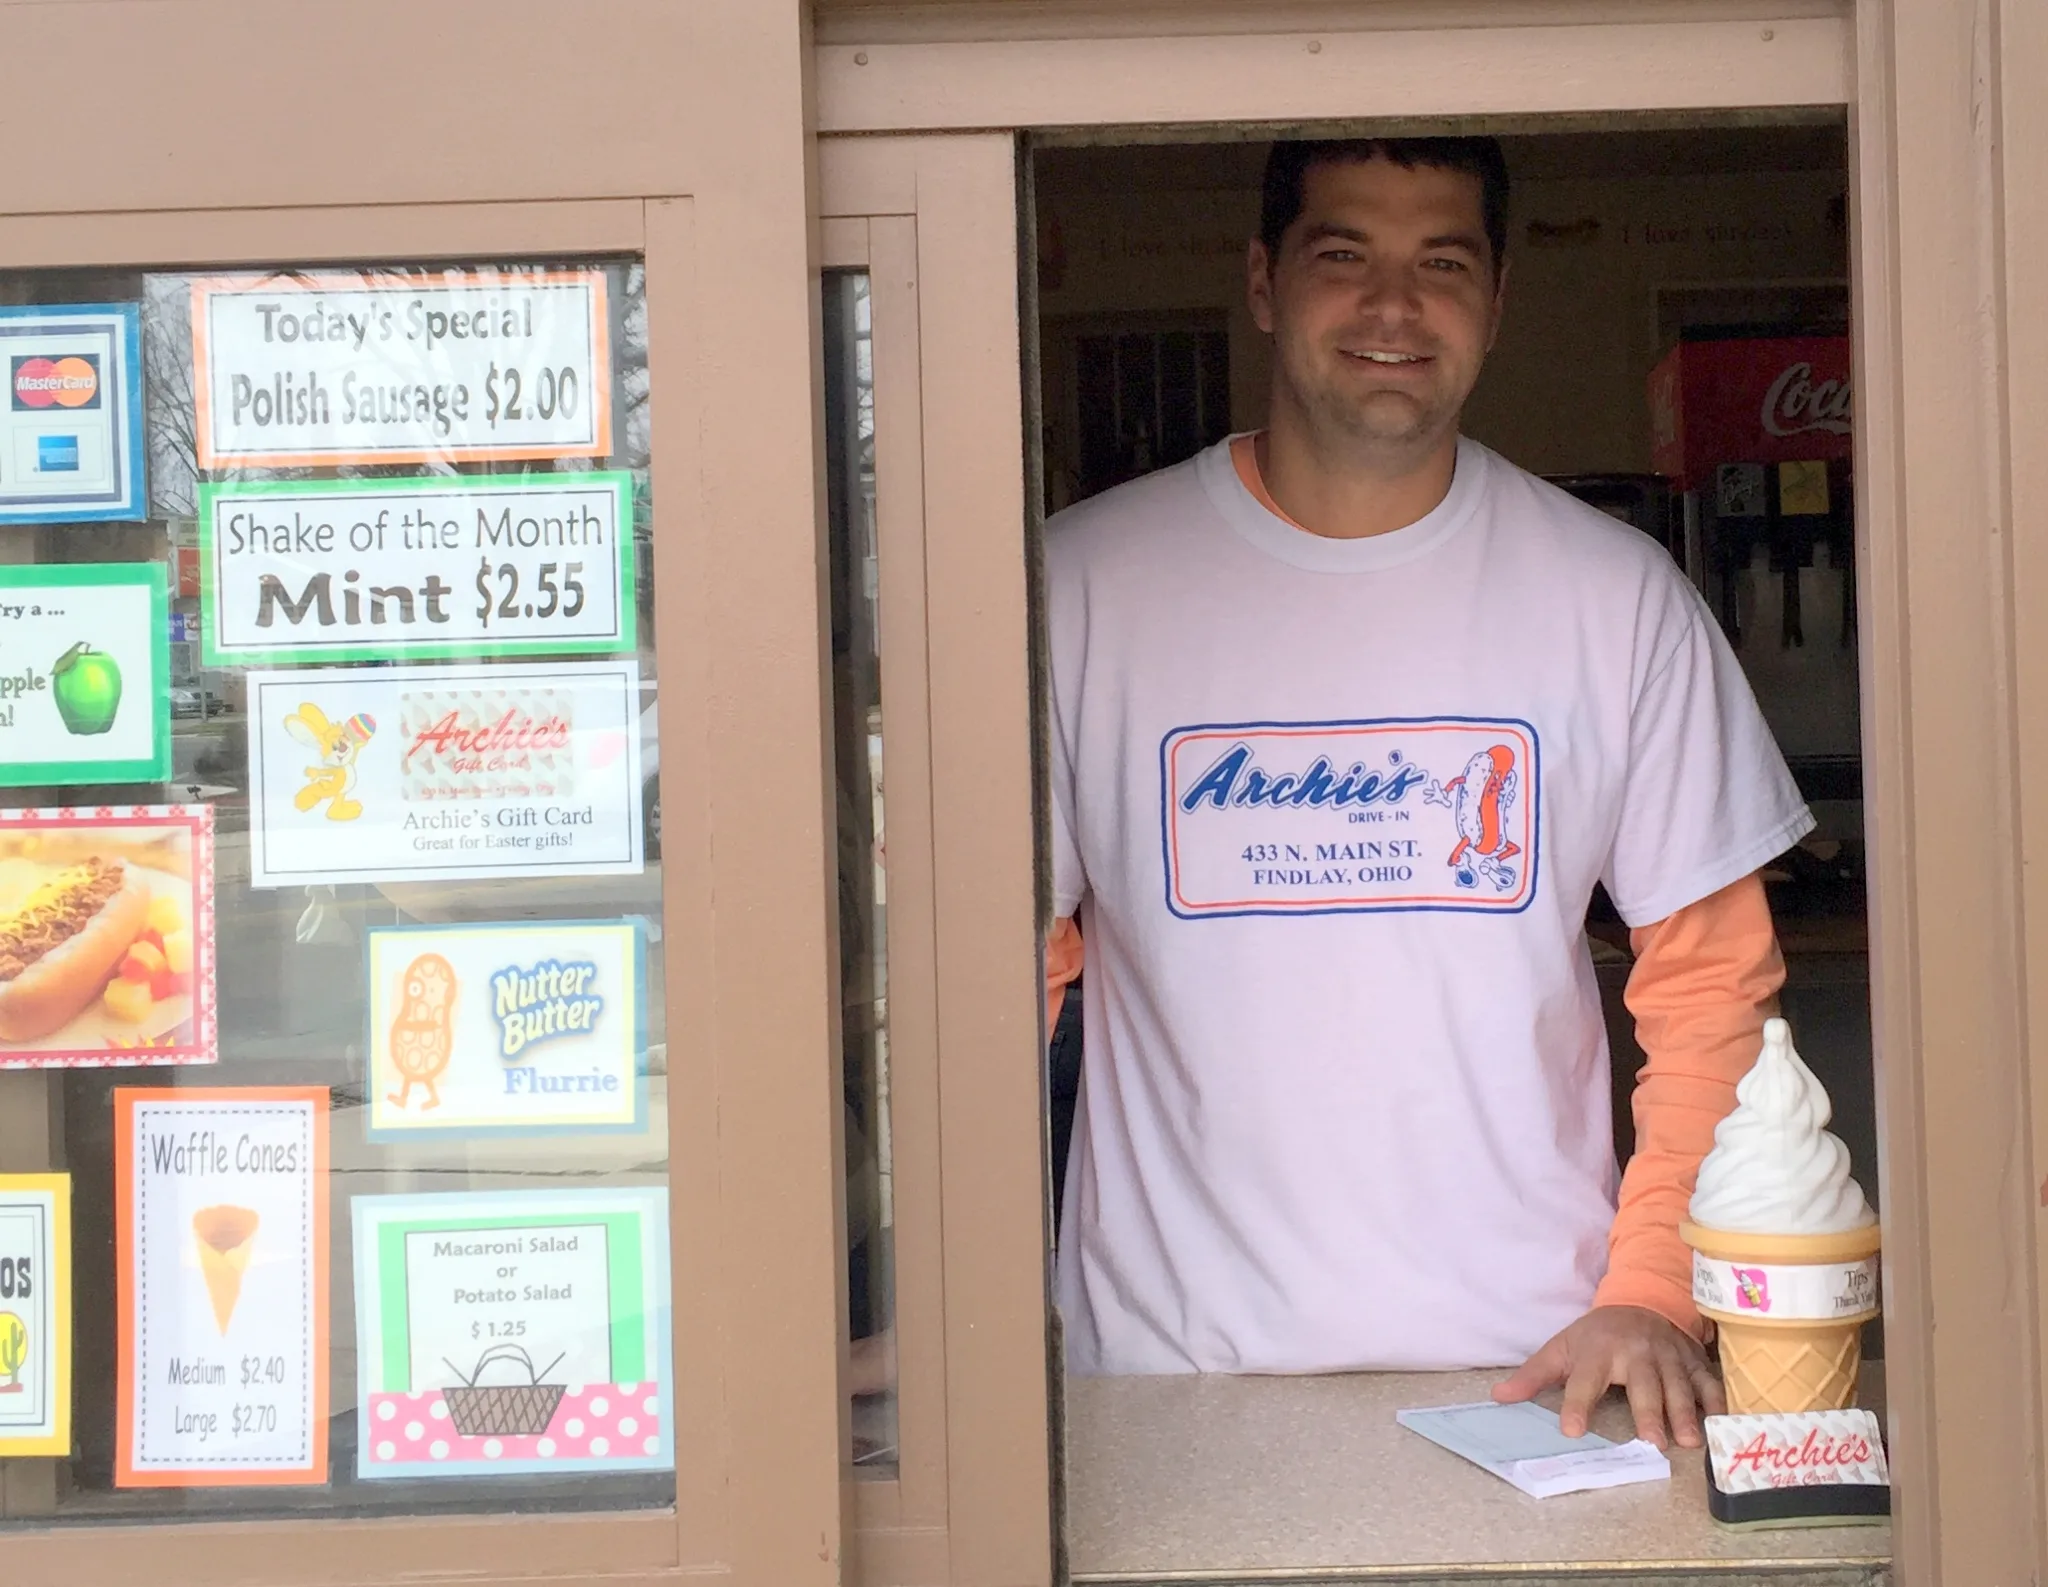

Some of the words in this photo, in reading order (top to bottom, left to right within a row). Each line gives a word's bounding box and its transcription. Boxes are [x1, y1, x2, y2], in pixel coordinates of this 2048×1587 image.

[255, 303, 393, 350] Today's
[407, 298, 533, 350] Special
[16, 375, 96, 392] MasterCard
[231, 371, 330, 428] Polish
[342, 369, 469, 437] Sausage
[486, 360, 580, 430] $2.00
[229, 511, 335, 556] Shake
[350, 508, 392, 552] of
[401, 508, 460, 551] the
[475, 503, 603, 549] Month
[254, 569, 453, 629] Mint
[476, 556, 586, 629] $2.55
[0, 603, 25, 619] ry
[31, 604, 42, 616] a
[407, 707, 571, 757] Archie's
[453, 757, 483, 775] Gift
[1180, 741, 1429, 815] Archie's
[497, 806, 538, 827] Gift
[545, 805, 594, 826] Card
[413, 836, 454, 851] Great
[460, 834, 480, 850] for
[485, 834, 531, 849] Easter
[535, 831, 574, 851] gifts!
[1241, 843, 1279, 864] 433
[1284, 845, 1308, 863] N.
[1315, 840, 1383, 862] MAIN
[1388, 839, 1423, 860] ST.
[1253, 867, 1352, 886] FINDLAY,
[1358, 865, 1413, 883] OHIO
[493, 963, 594, 1018] Nutter
[502, 997, 600, 1056] Butter
[502, 1066, 619, 1095] Flurrie
[151, 1131, 229, 1177] Waffle
[235, 1132, 298, 1174] Cones
[433, 1237, 523, 1258] Macaroni
[529, 1235, 579, 1254] Salad
[496, 1265, 518, 1279] or
[1844, 1269, 1869, 1291] Tips
[453, 1287, 517, 1305] Potato
[523, 1283, 573, 1302] Salad
[168, 1356, 226, 1386] Medium
[240, 1353, 285, 1390] $2.40
[175, 1404, 218, 1442] Large
[231, 1402, 277, 1439] $2.70
[1728, 1427, 1872, 1476] Archie's
[1802, 1470, 1836, 1486] Card
